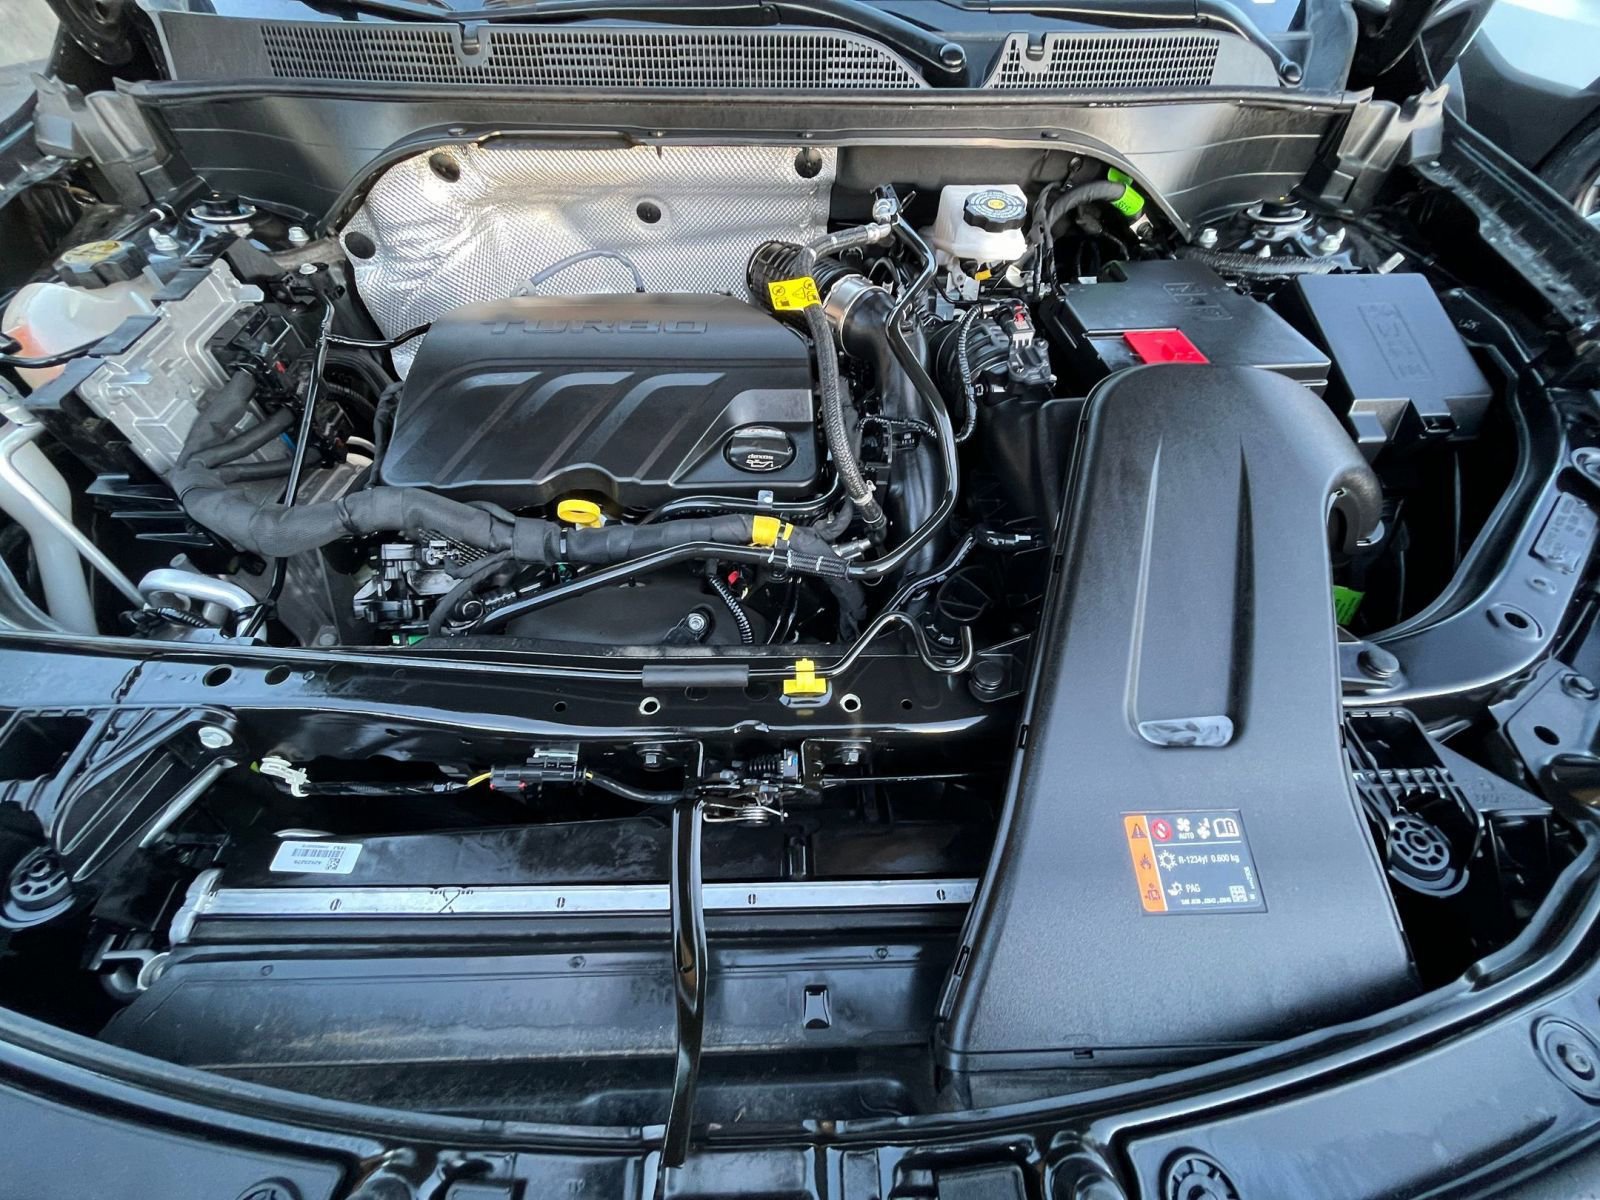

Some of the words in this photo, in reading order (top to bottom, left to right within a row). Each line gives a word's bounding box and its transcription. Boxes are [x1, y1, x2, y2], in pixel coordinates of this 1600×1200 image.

[480, 320, 708, 334] TURBO
[1178, 832, 1195, 840] AUTO
[1178, 854, 1208, 865] R-1234yf
[1230, 853, 1240, 863] kg
[1185, 883, 1201, 893] PAG
